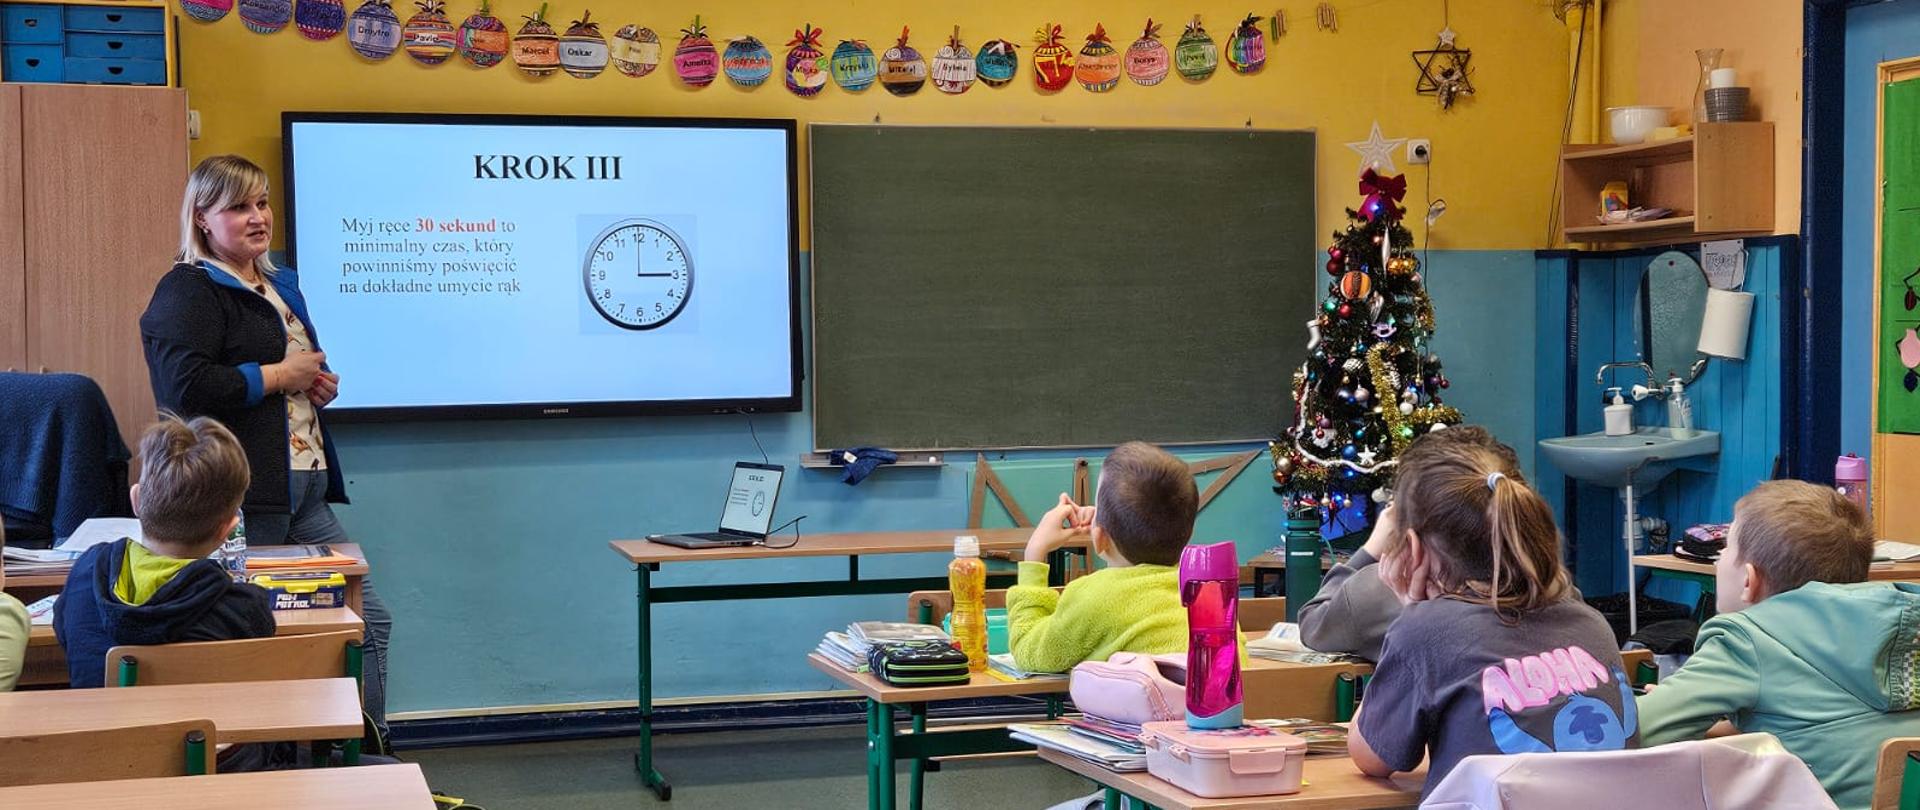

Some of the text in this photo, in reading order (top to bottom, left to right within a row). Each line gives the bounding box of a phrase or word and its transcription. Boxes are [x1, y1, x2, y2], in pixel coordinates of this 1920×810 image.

[567, 48, 592, 57] Oskar
[473, 154, 623, 180] KROK III
[342, 217, 516, 236] Myj ręce 30 sekund to
[633, 232, 646, 243] 12
[344, 238, 514, 256] minimalny czas, który
[615, 239, 626, 249] 11
[601, 251, 614, 262] 10
[666, 251, 674, 262] 2
[342, 257, 517, 274] powinniśmy poświęcić
[599, 270, 606, 281] 9
[672, 269, 680, 280] 3
[339, 278, 521, 296] na dokładne umycie rąk
[604, 289, 611, 299] 8
[667, 288, 675, 298] 4
[619, 303, 626, 313] 7
[636, 308, 644, 317] 6
[655, 302, 663, 313] 5
[1482, 645, 1609, 716] ALOHA
